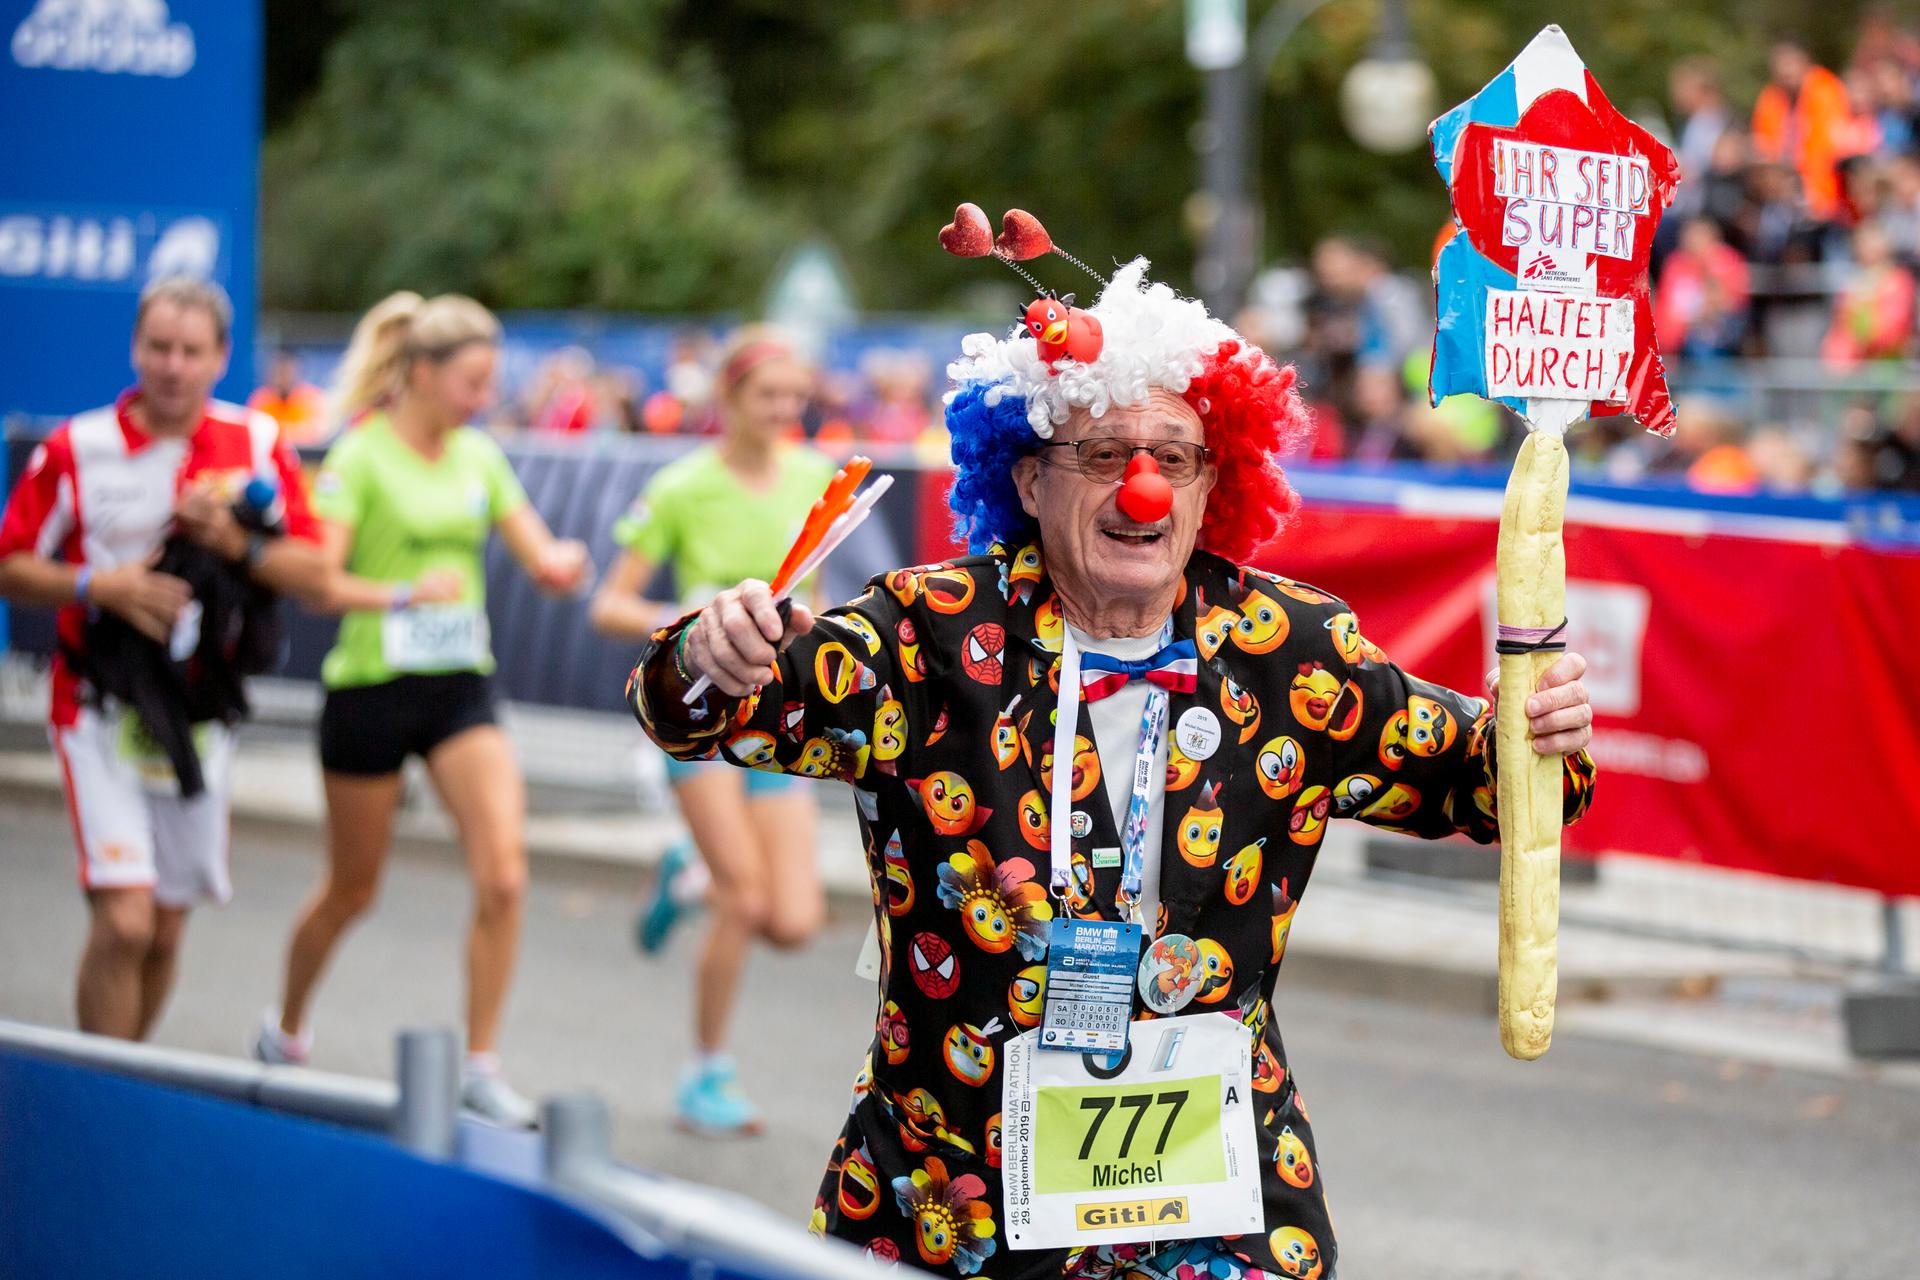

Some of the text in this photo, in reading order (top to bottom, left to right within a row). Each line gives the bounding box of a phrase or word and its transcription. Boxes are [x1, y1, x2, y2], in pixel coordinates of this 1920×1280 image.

[1495, 141, 1649, 211] IHR SEID
[1504, 198, 1634, 258] SUPER
[1494, 297, 1612, 338] HALTET
[1074, 943, 1116, 952] MARATHON
[1076, 927, 1102, 937] BMW
[1225, 1086, 1240, 1105] A
[1008, 1044, 1020, 1226] 46. BMW BERLIN-MARATHON
[1077, 1090, 1189, 1160] 777
[1019, 1115, 1031, 1225] 29. September 2019
[1092, 1160, 1163, 1187] Michel
[1083, 1205, 1146, 1226] Giti
